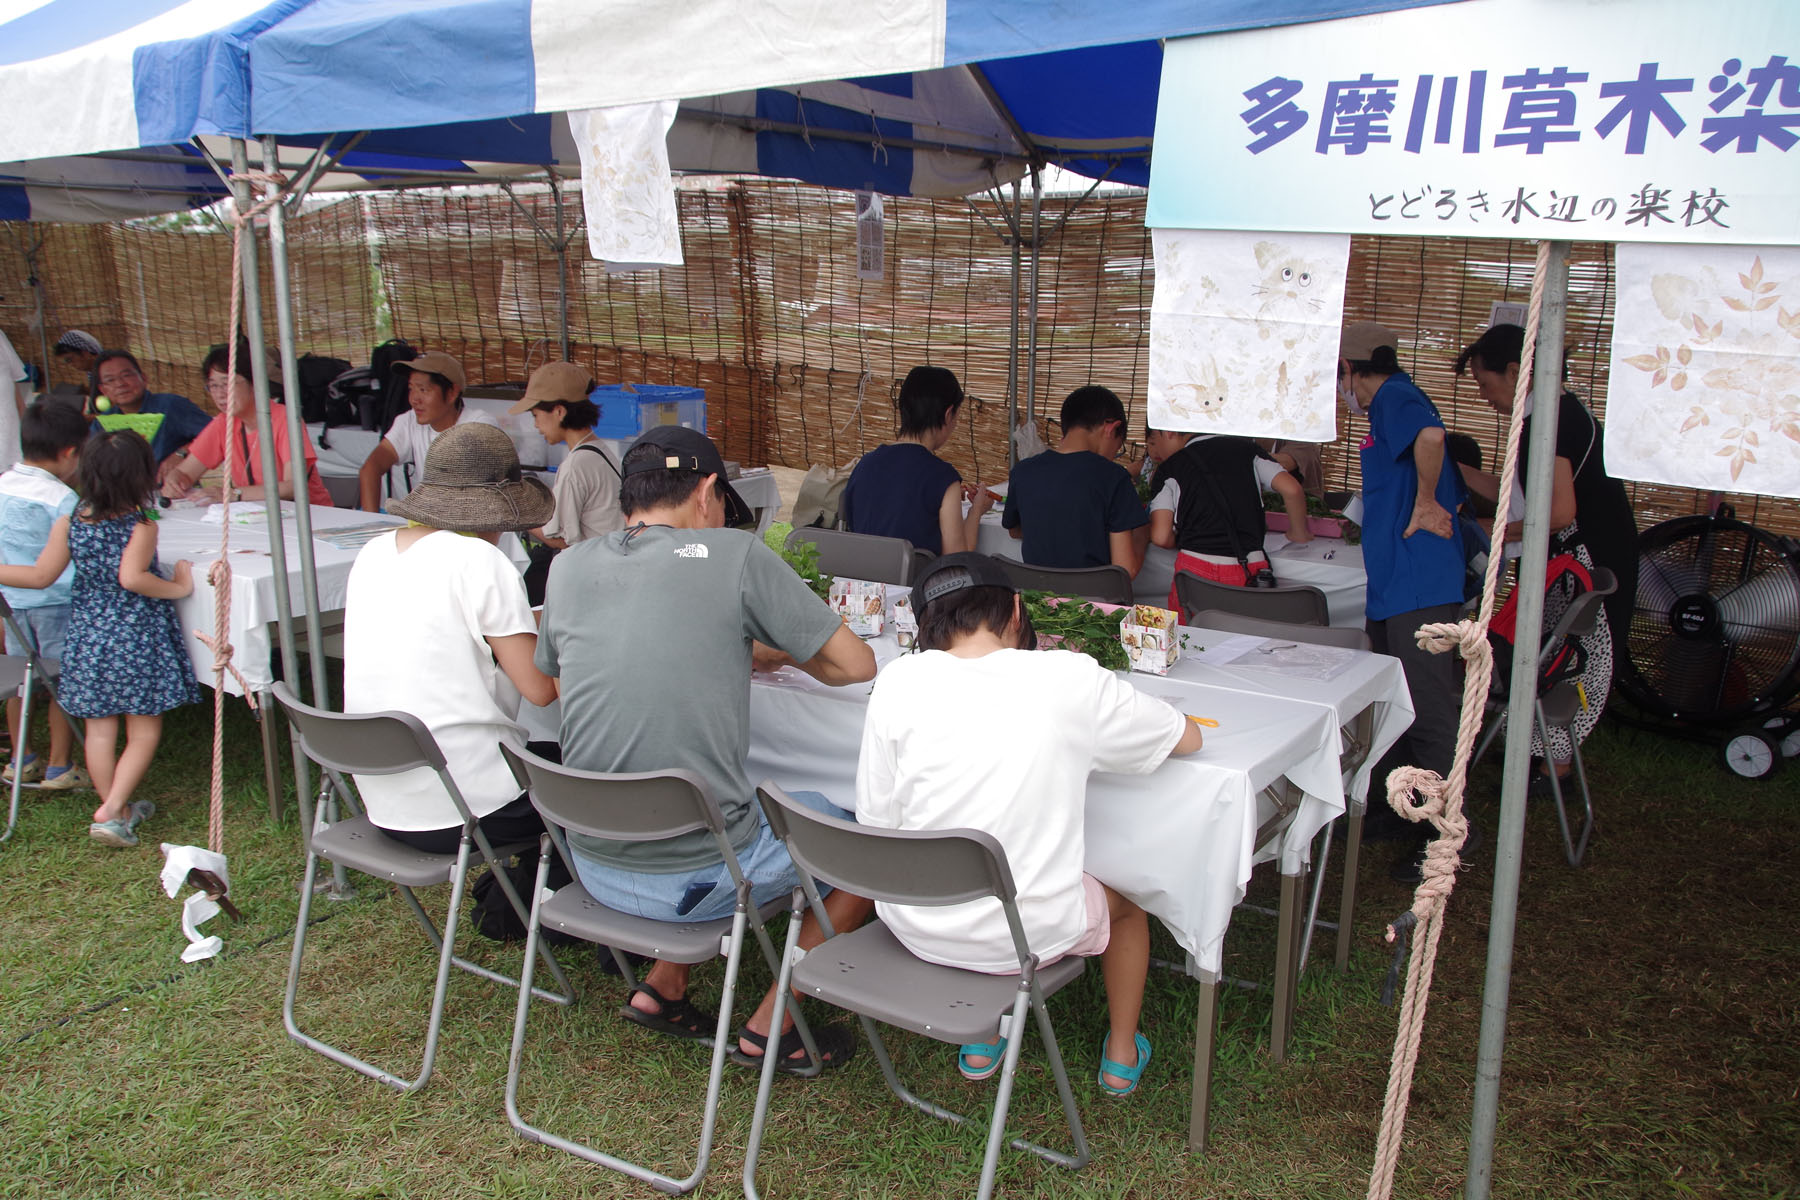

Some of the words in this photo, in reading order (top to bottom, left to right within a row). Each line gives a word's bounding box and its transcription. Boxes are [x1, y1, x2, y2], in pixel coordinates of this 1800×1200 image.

[1239, 55, 1800, 156] 多摩川草木染
[1369, 183, 1731, 229] とどろき水辺の楽校
